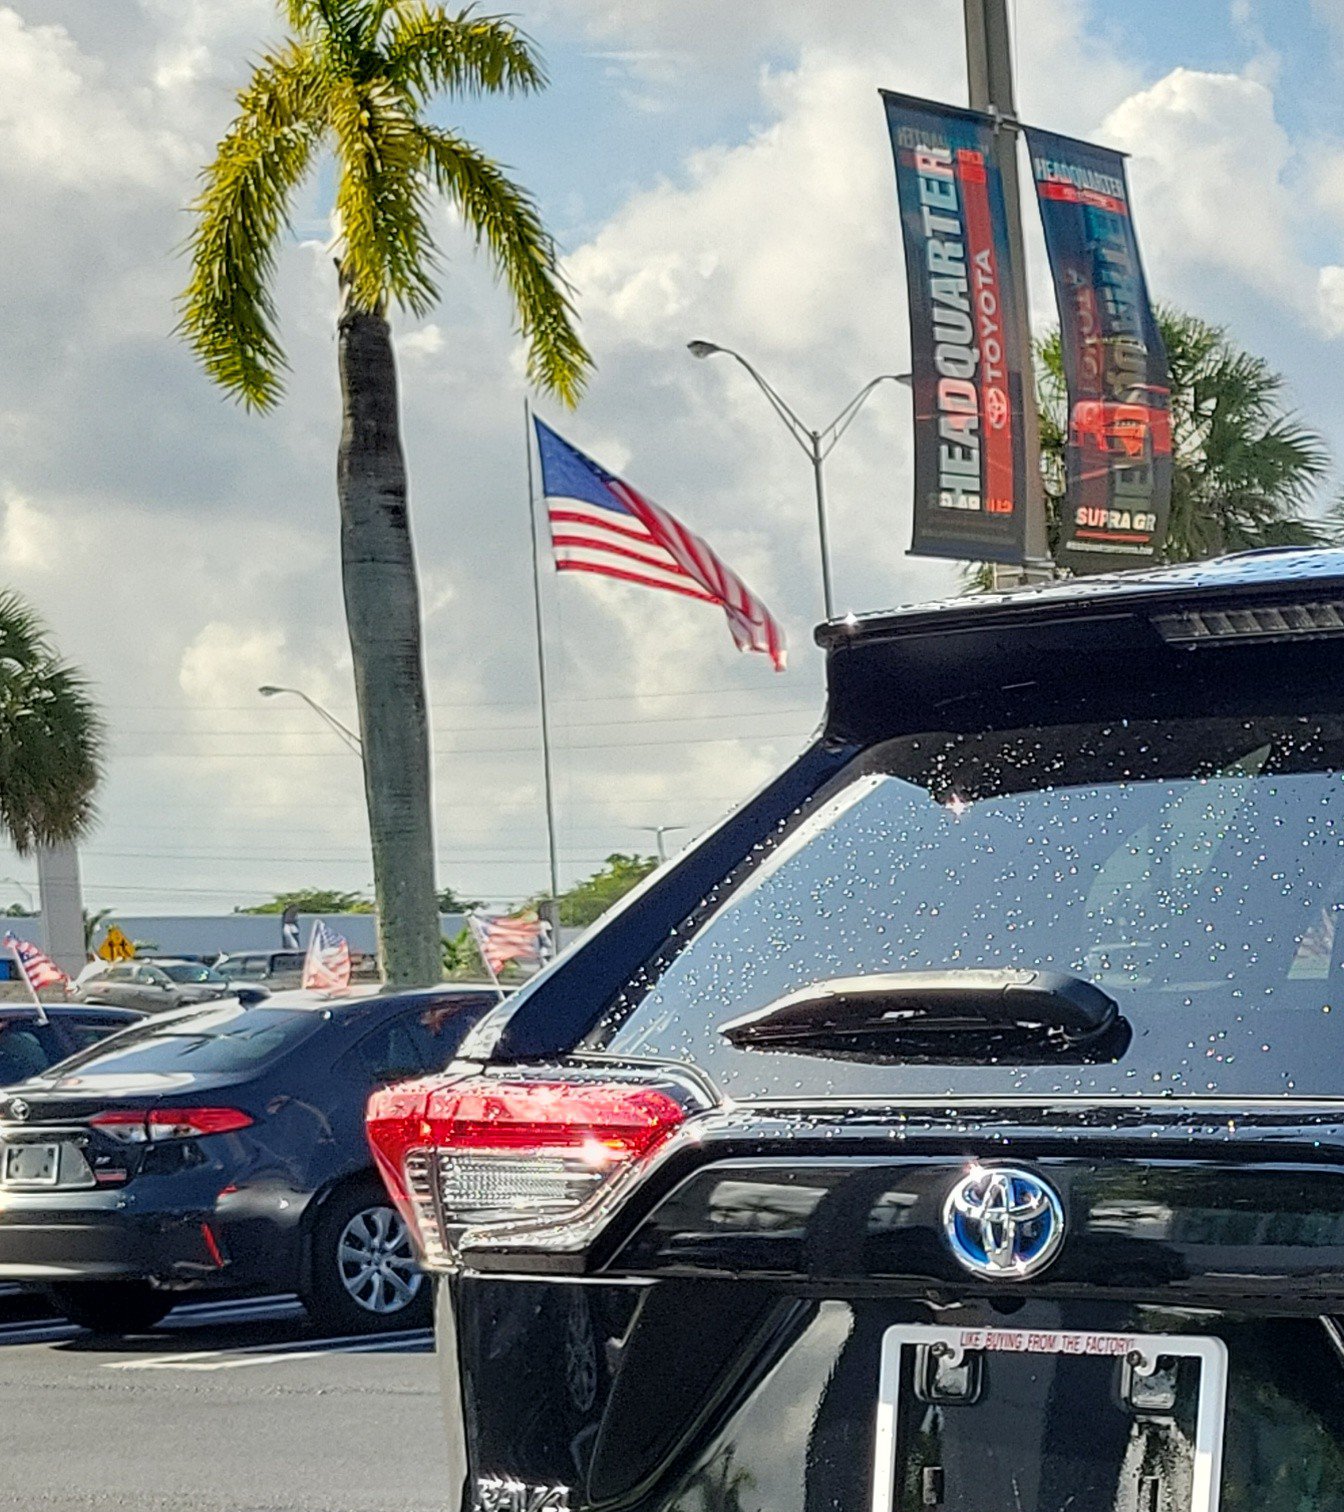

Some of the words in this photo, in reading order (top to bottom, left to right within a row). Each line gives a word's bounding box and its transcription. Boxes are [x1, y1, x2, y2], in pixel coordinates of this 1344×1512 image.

[916, 150, 982, 510] HEADQUARTER
[974, 248, 1004, 383] TOYOTA
[1076, 506, 1131, 530] SUPRA
[1132, 512, 1156, 532] GR
[960, 1331, 981, 1348] LIKE
[985, 1332, 1022, 1350] BUYING
[1026, 1333, 1058, 1351] FROM
[1062, 1334, 1081, 1352] THE
